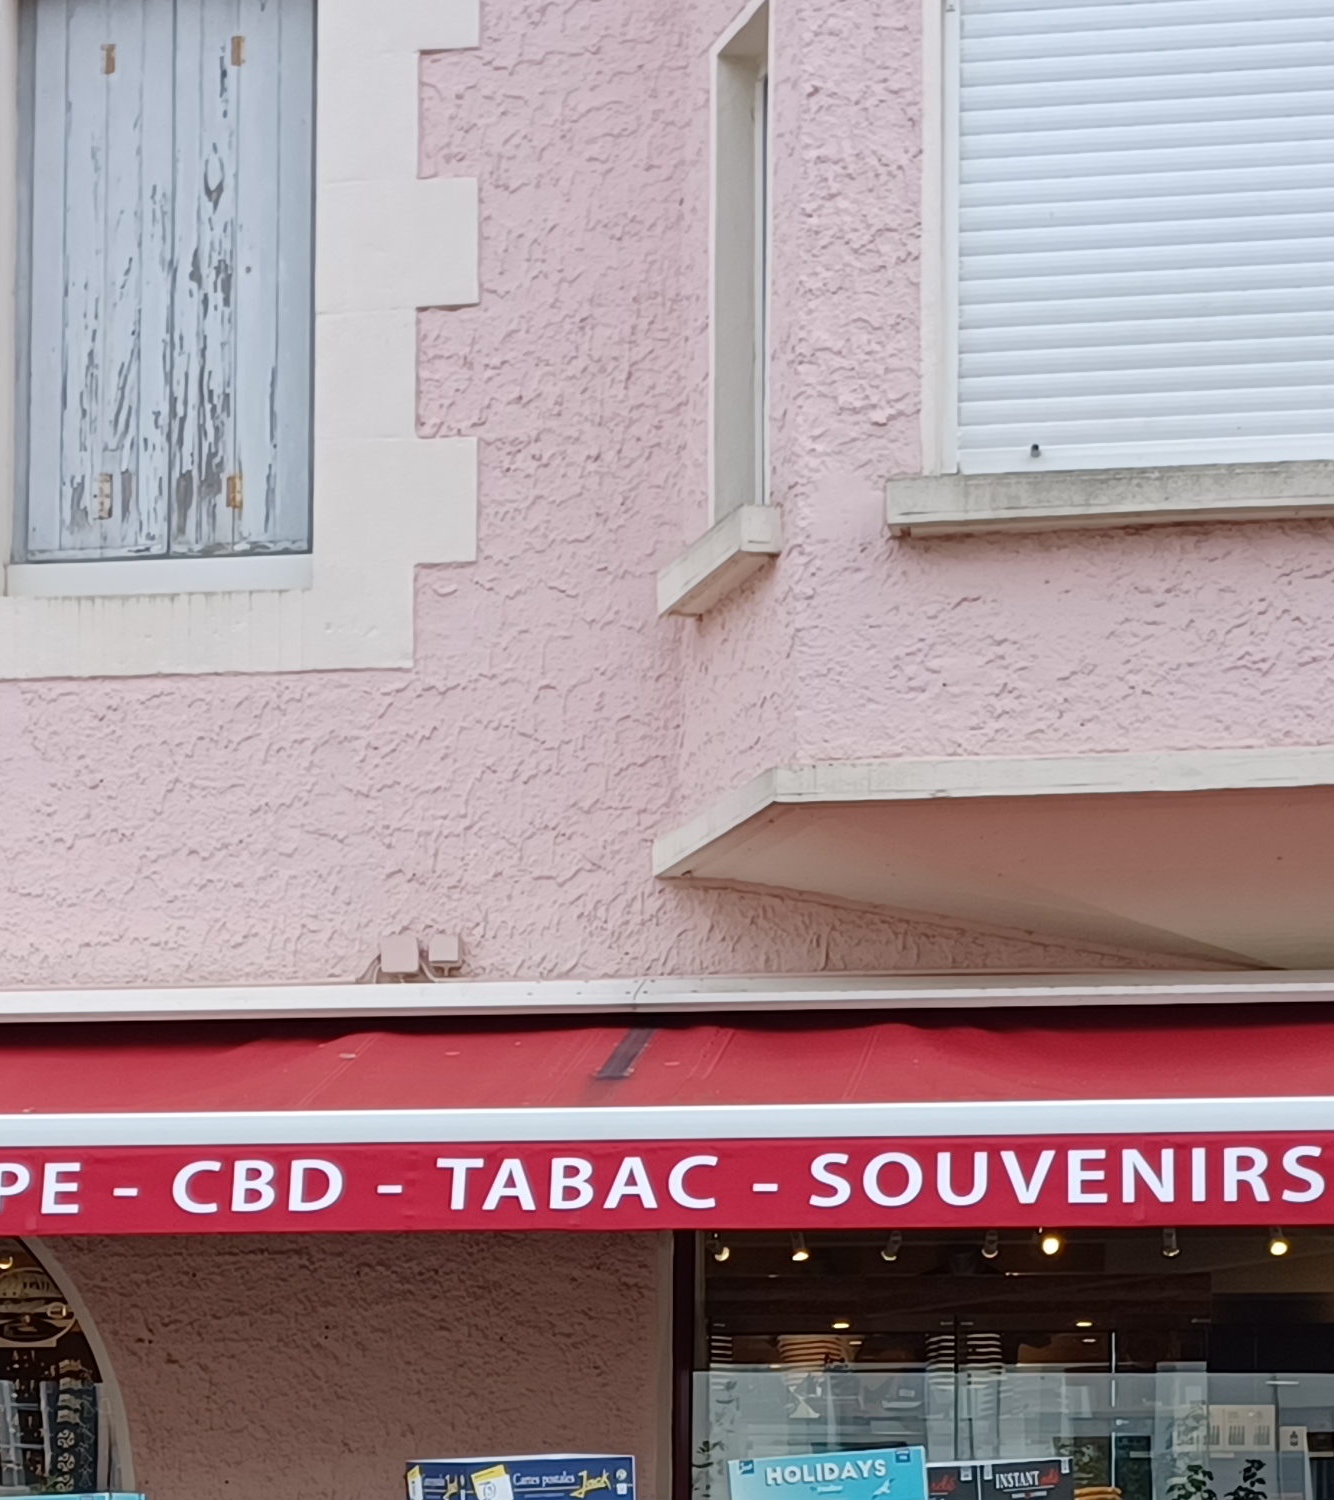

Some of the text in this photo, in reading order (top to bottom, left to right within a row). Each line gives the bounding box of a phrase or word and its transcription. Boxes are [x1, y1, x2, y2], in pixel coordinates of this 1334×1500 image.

[172, 1158, 343, 1214] CBD
[437, 1155, 718, 1211] TABAC
[808, 1145, 1326, 1207] SOUVENIRS
[570, 1468, 611, 1498] Jack
[765, 1459, 886, 1486] HOLIDAYS
[996, 1471, 1039, 1489] INSTANT
